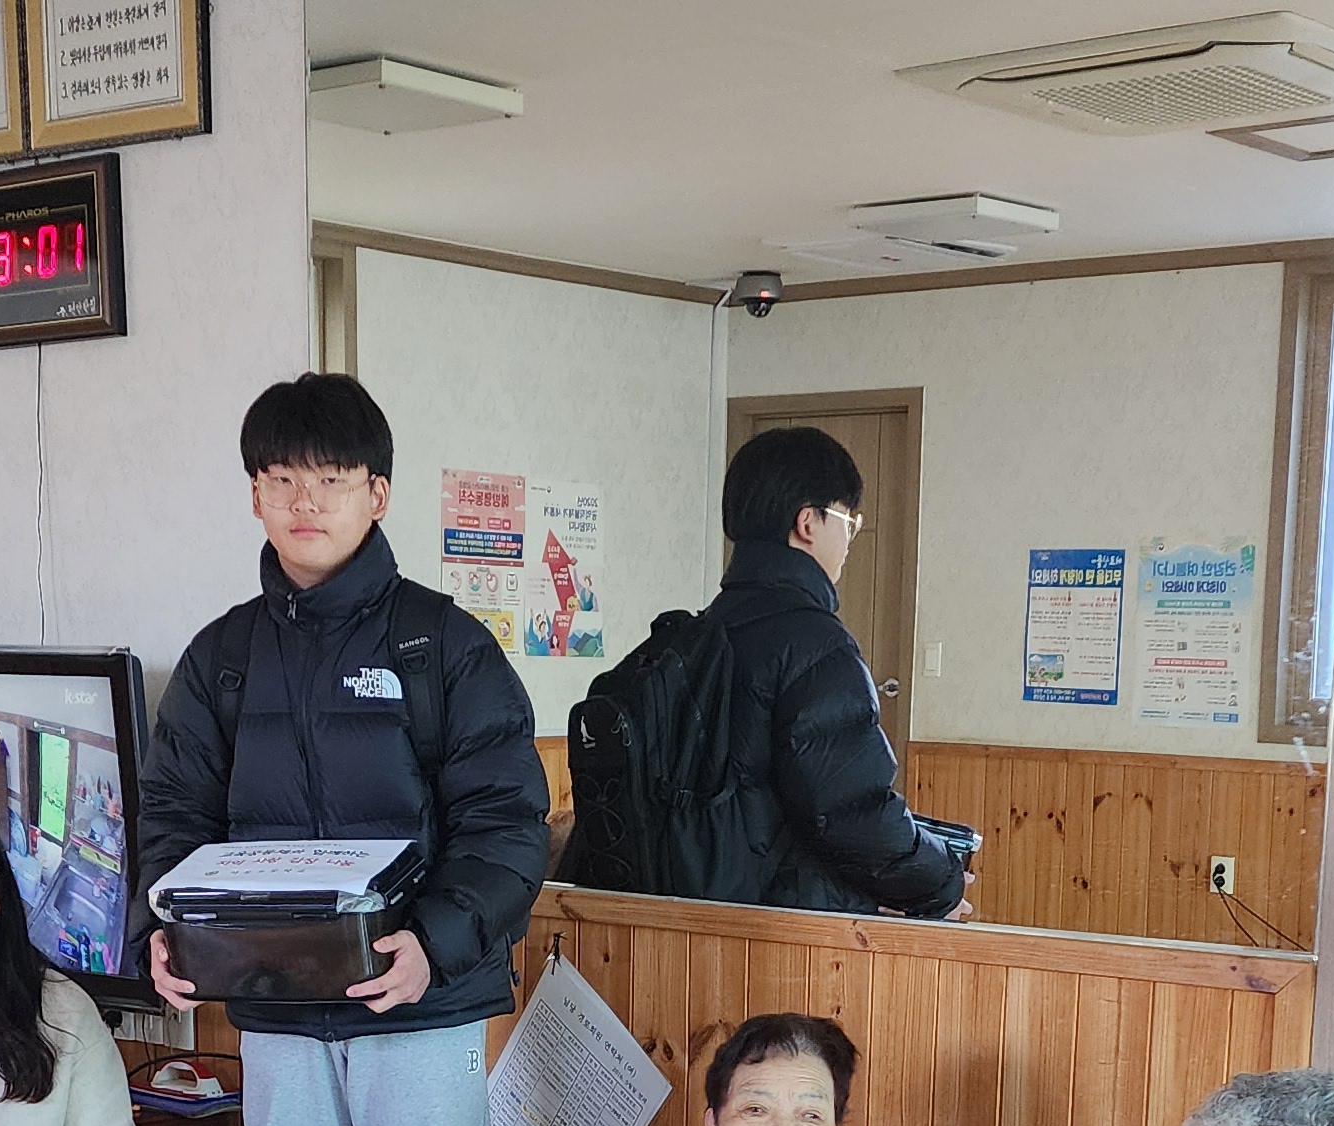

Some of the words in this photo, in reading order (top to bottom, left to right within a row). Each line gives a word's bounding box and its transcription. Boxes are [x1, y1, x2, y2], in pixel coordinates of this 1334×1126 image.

[4, 206, 50, 221] PHAROS
[398, 636, 430, 649] KANGOL
[359, 667, 382, 679] THE
[343, 676, 382, 688] NORTH
[354, 687, 383, 697] FACE
[467, 1048, 480, 1073] B
